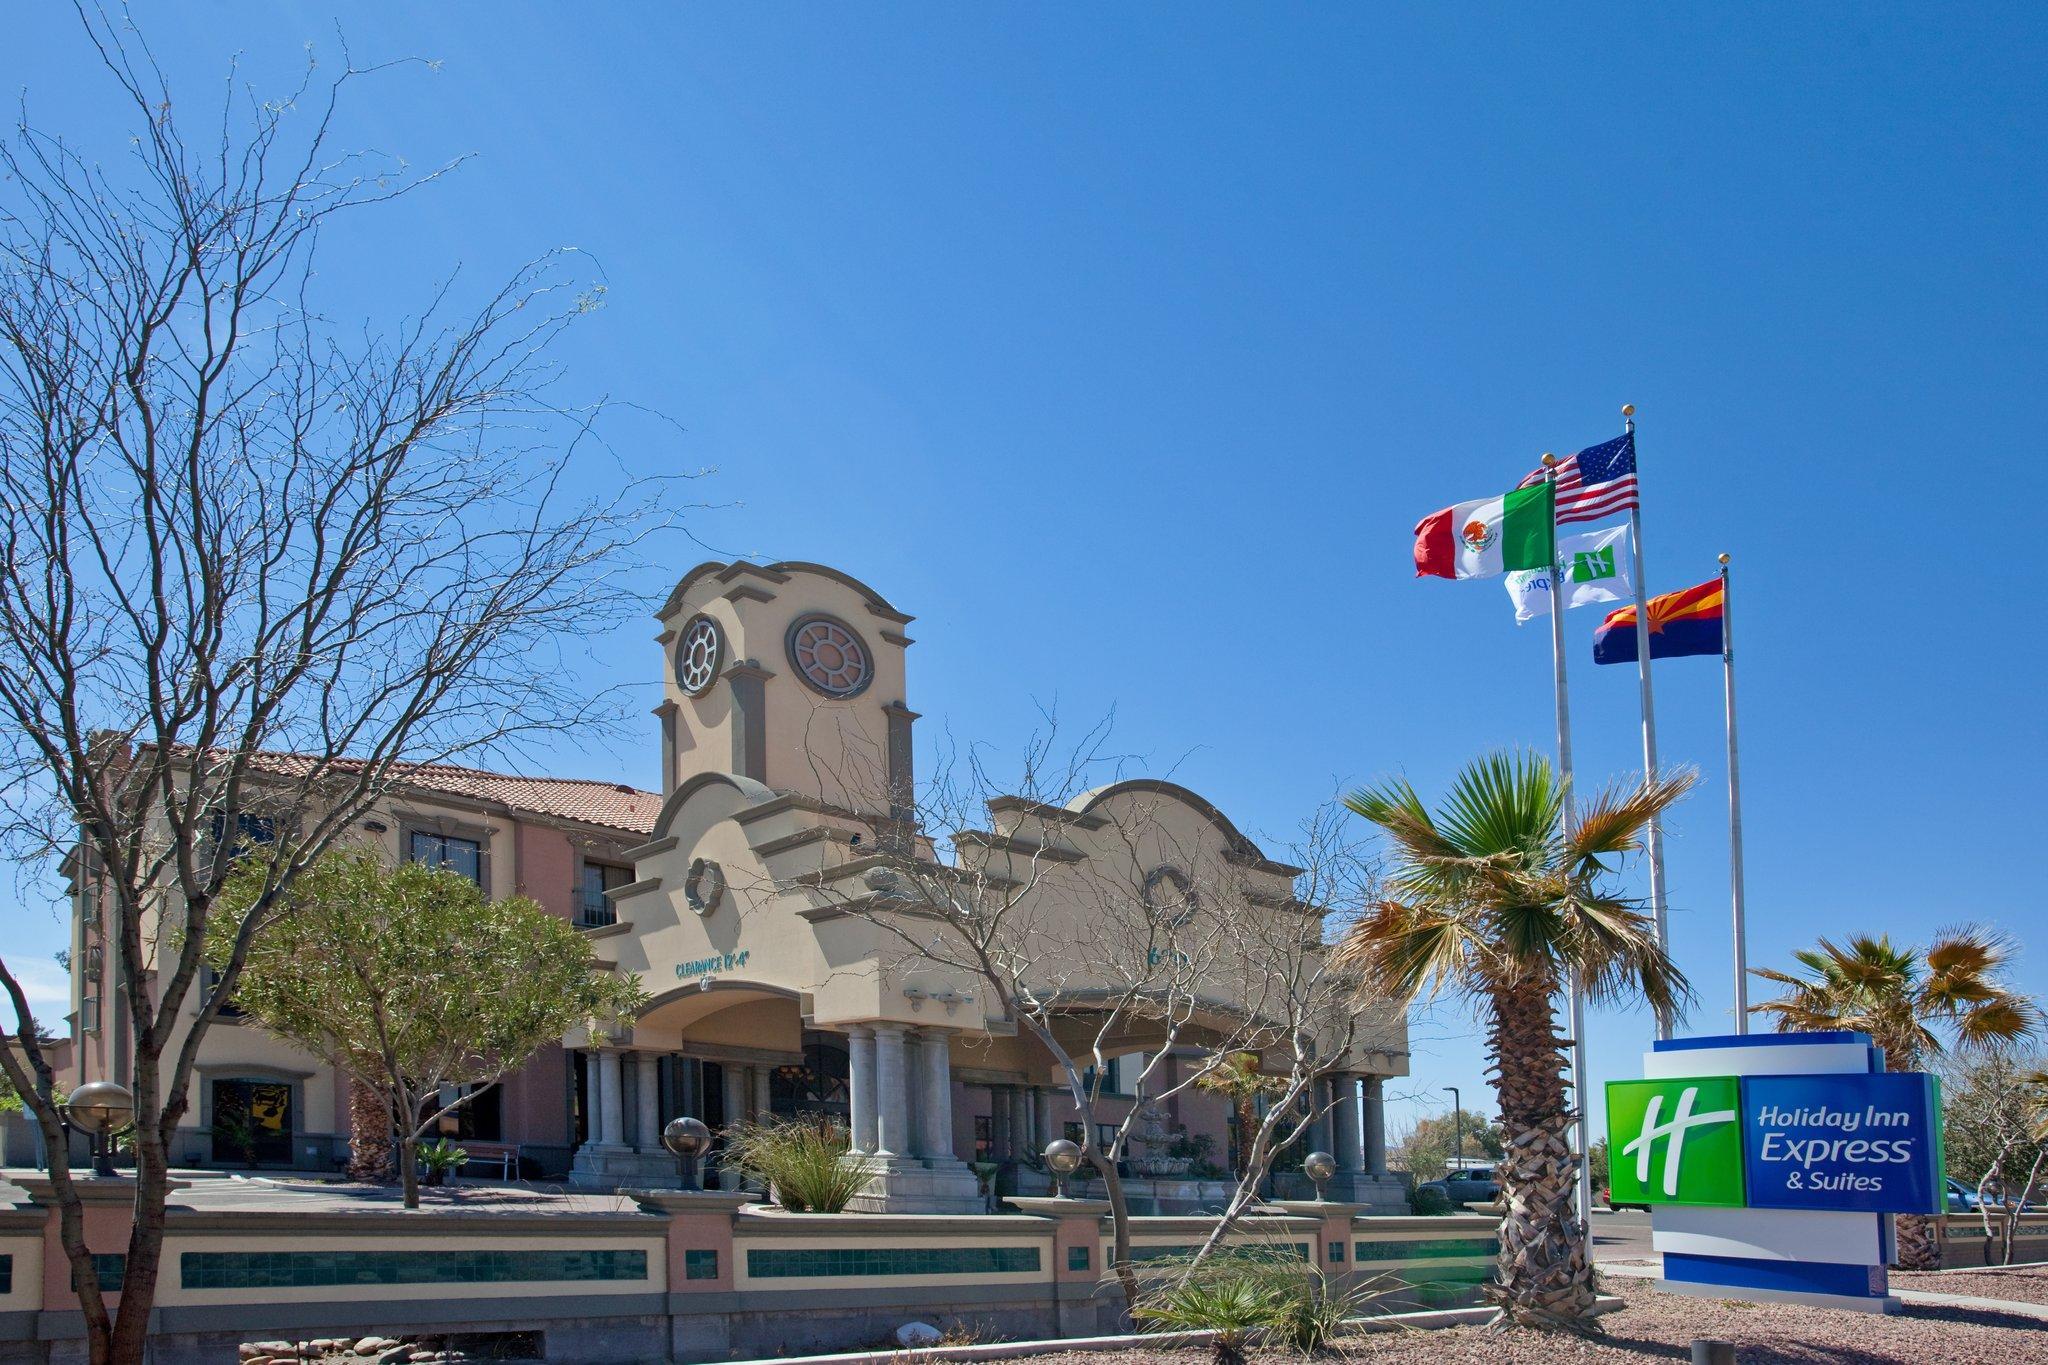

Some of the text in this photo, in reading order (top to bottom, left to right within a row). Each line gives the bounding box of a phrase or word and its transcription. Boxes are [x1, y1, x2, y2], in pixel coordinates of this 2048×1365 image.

[676, 955, 723, 978] CLEARANCE
[1757, 1104, 1910, 1132] Holiday Inn
[1760, 1132, 1912, 1170] Express
[1786, 1171, 1883, 1191] & Suites
